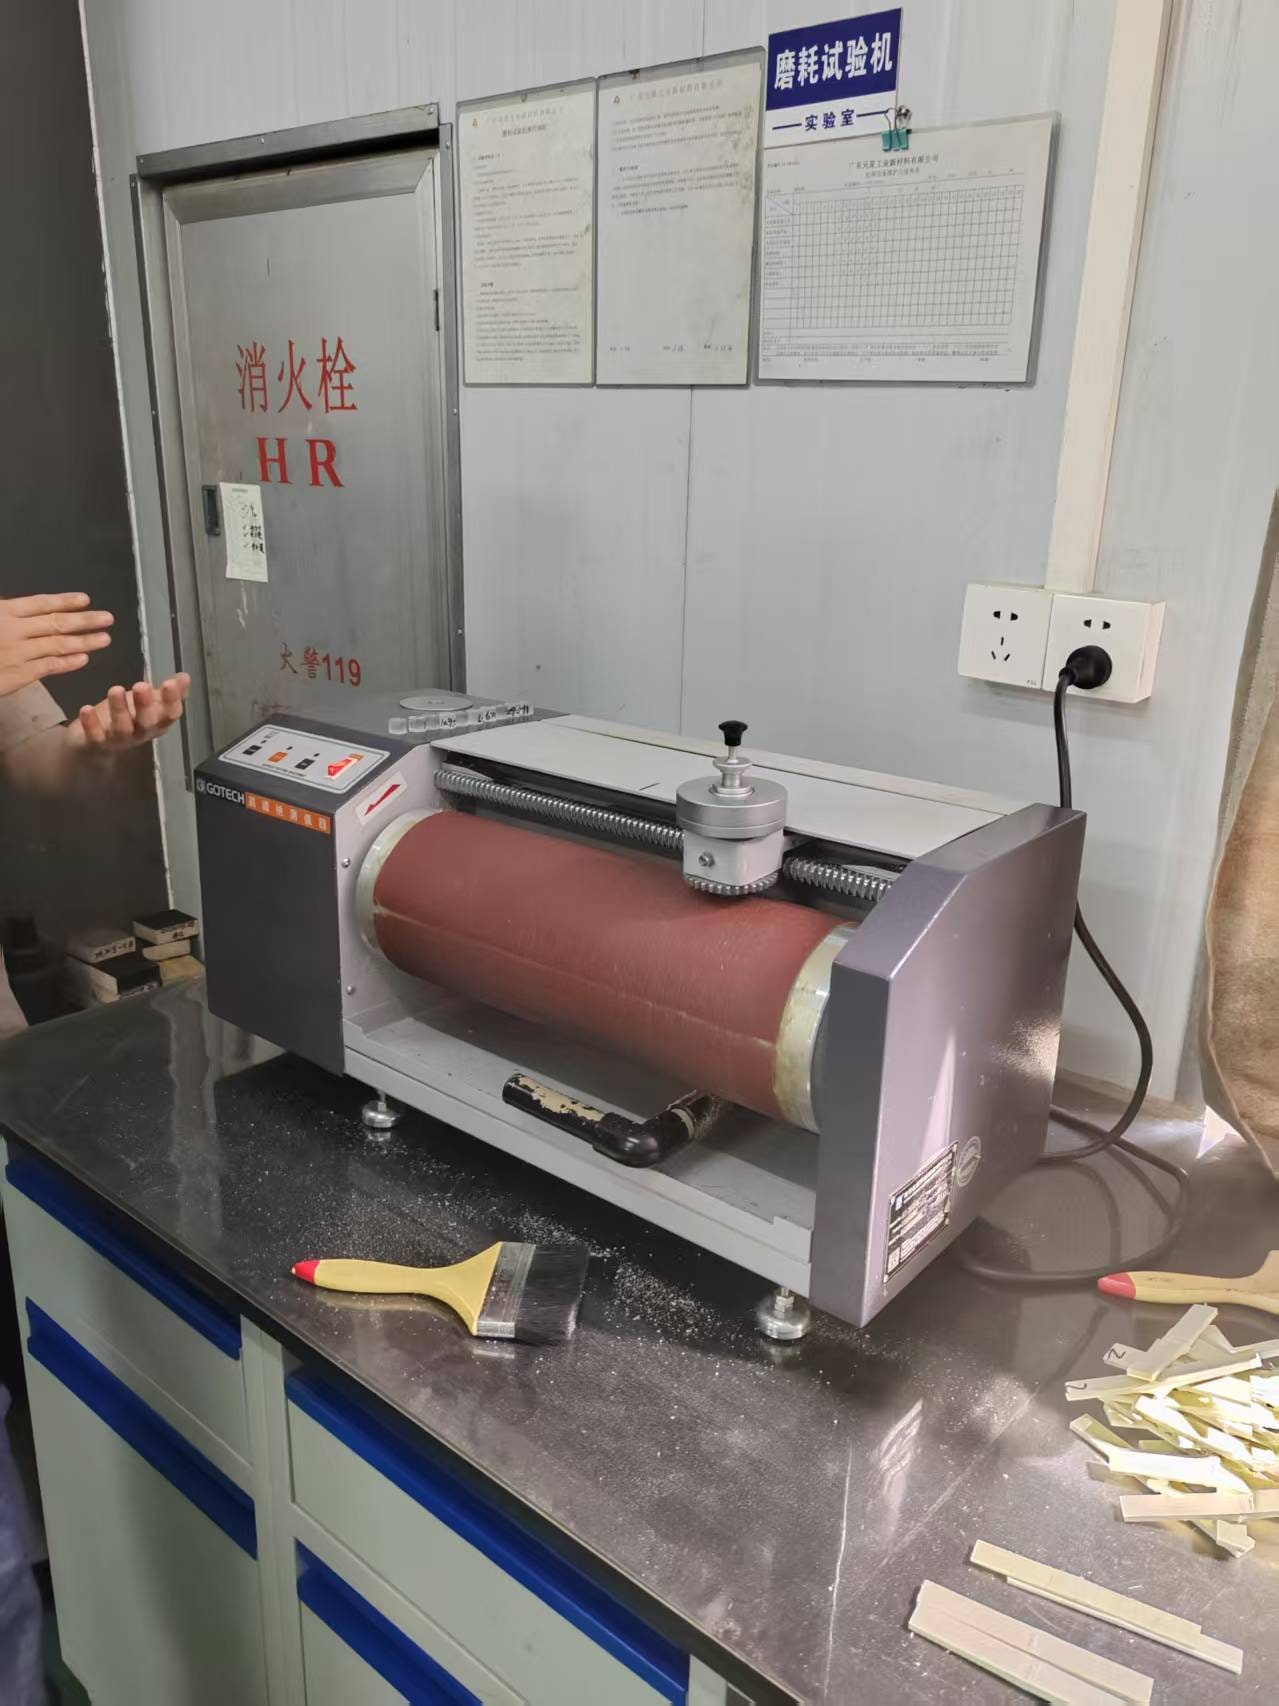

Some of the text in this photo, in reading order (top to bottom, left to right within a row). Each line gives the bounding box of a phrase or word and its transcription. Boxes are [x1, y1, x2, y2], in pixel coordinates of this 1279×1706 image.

[774, 32, 893, 90] 磨耗试验机
[804, 108, 855, 131] 实验室
[235, 336, 358, 414] 消火栓
[206, 782, 245, 805] GOTECH
